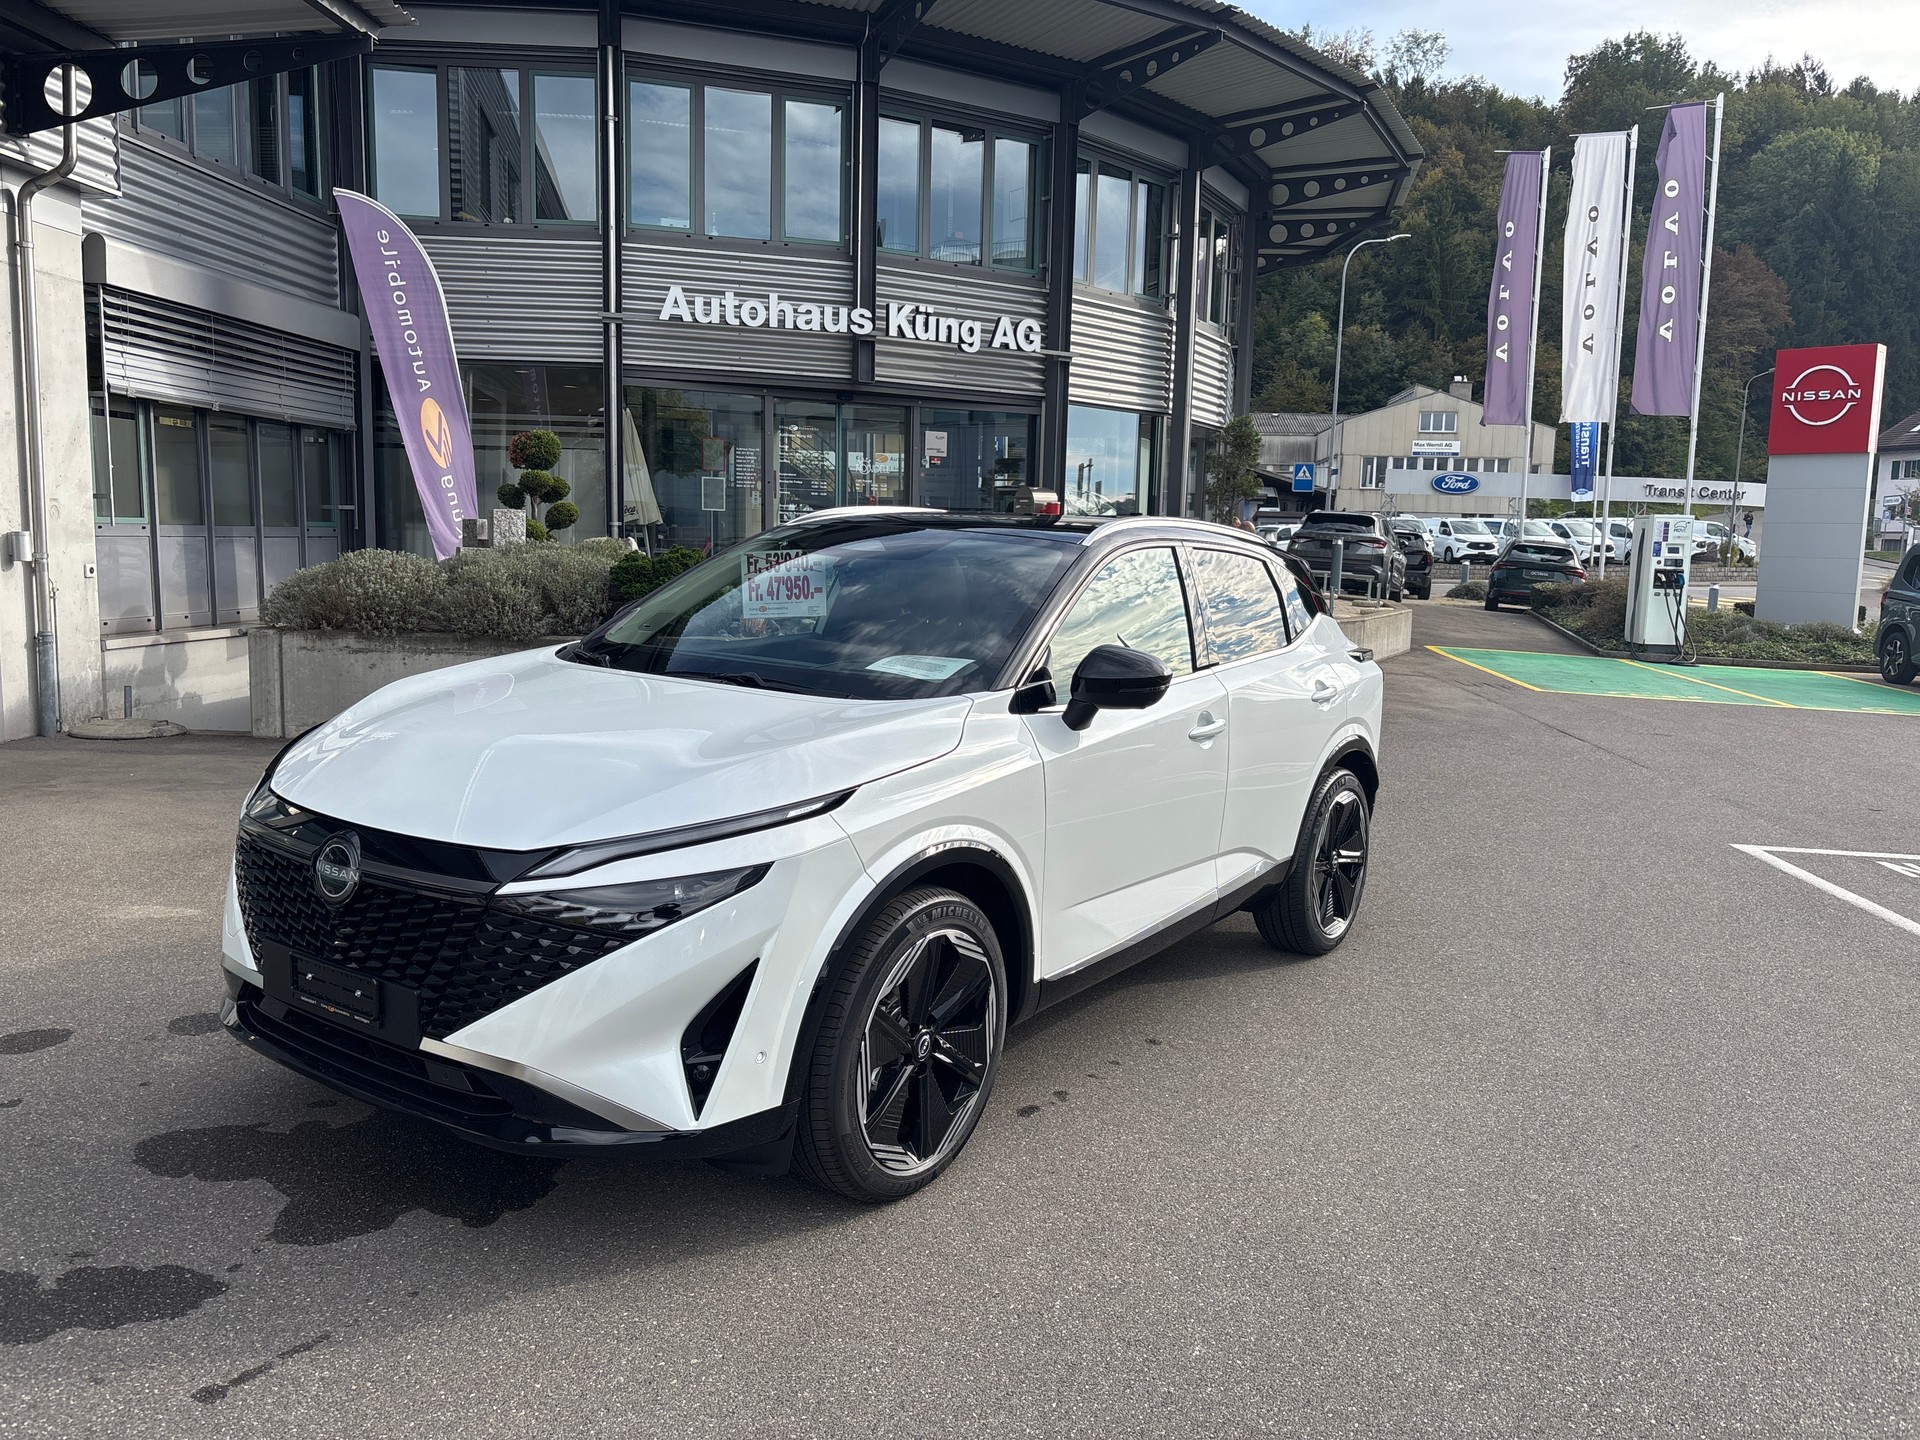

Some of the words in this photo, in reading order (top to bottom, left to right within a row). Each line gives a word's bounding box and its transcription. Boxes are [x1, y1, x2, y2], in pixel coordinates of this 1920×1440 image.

[658, 286, 874, 336] Autohaus
[887, 302, 982, 354] Küng
[992, 316, 1042, 352] AG
[1781, 388, 1862, 402] NISSAN
[1441, 475, 1471, 489] Ford
[1645, 484, 1695, 498] Transt
[1698, 486, 1747, 500] Center
[746, 553, 762, 574] Fr.
[748, 578, 763, 602] Fr.
[931, 906, 986, 930] MICHELIN
